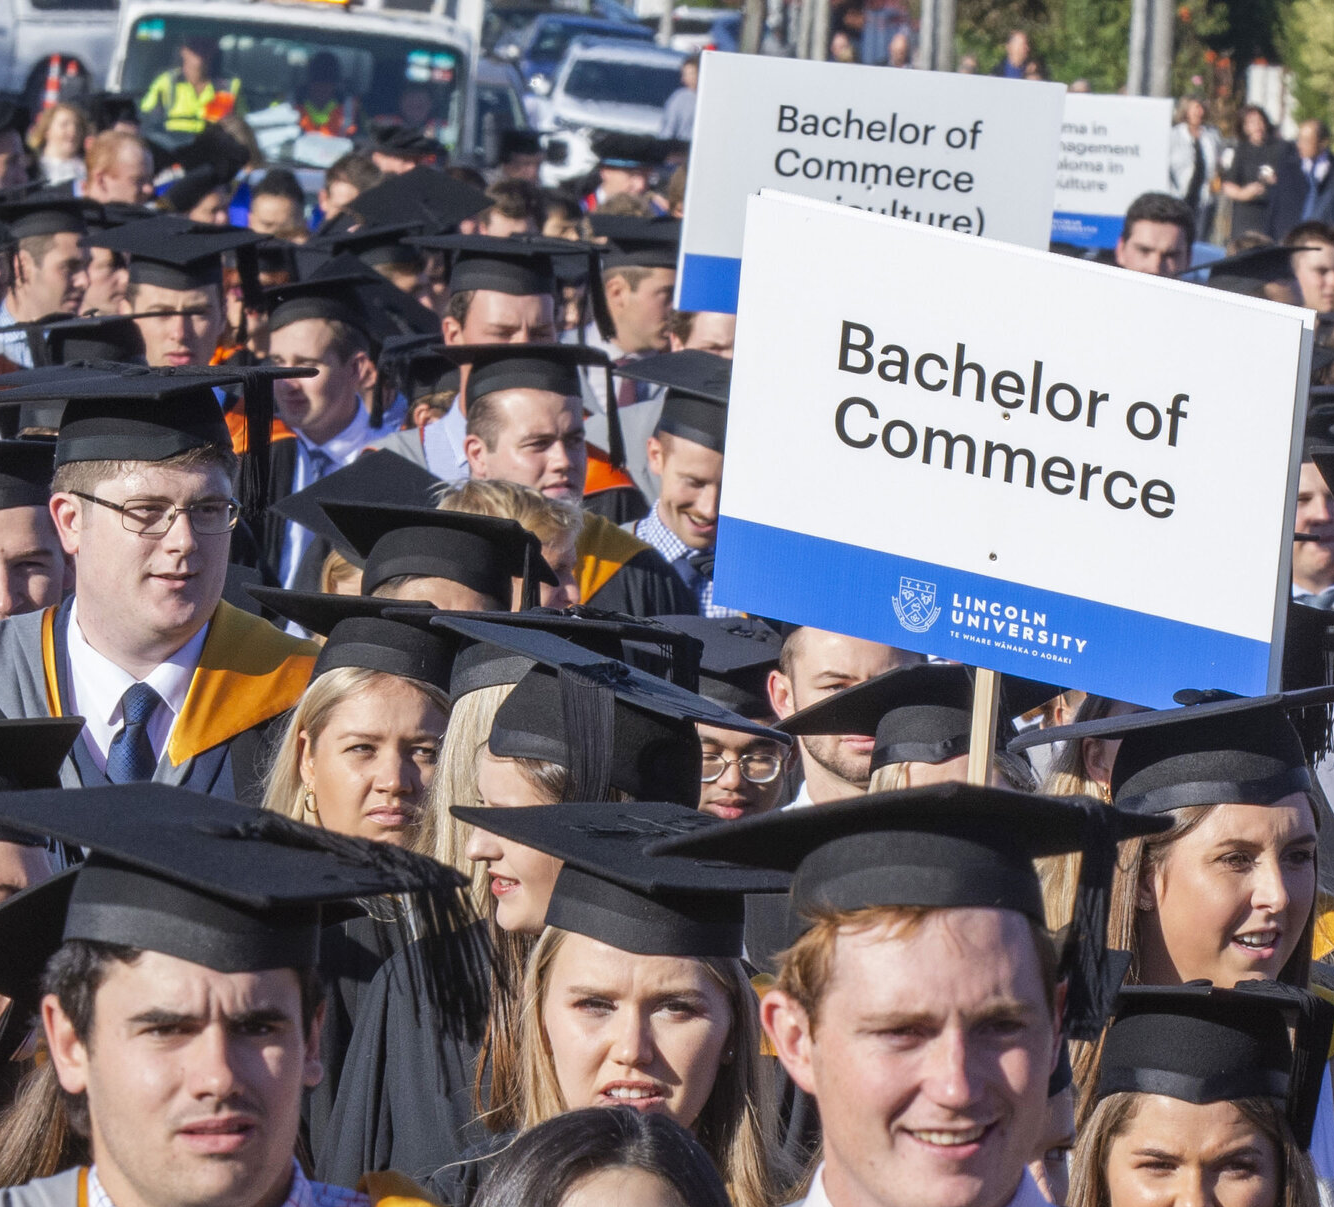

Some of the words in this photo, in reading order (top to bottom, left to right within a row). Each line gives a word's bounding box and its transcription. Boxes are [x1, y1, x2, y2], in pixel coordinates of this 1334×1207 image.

[778, 105, 936, 146] Bachelor
[946, 120, 984, 150] of
[774, 149, 974, 193] Commerce
[838, 319, 1110, 428] Bachelor
[1126, 393, 1190, 447] of
[835, 396, 1176, 519] Commerce
[951, 610, 1087, 653] UNIVERSITY
[953, 593, 1047, 627] LINCOLN
[950, 630, 960, 639] TE
[963, 634, 991, 646] WHARE
[994, 641, 1029, 655] WĀNAKA
[1041, 652, 1072, 665] AORAKI
